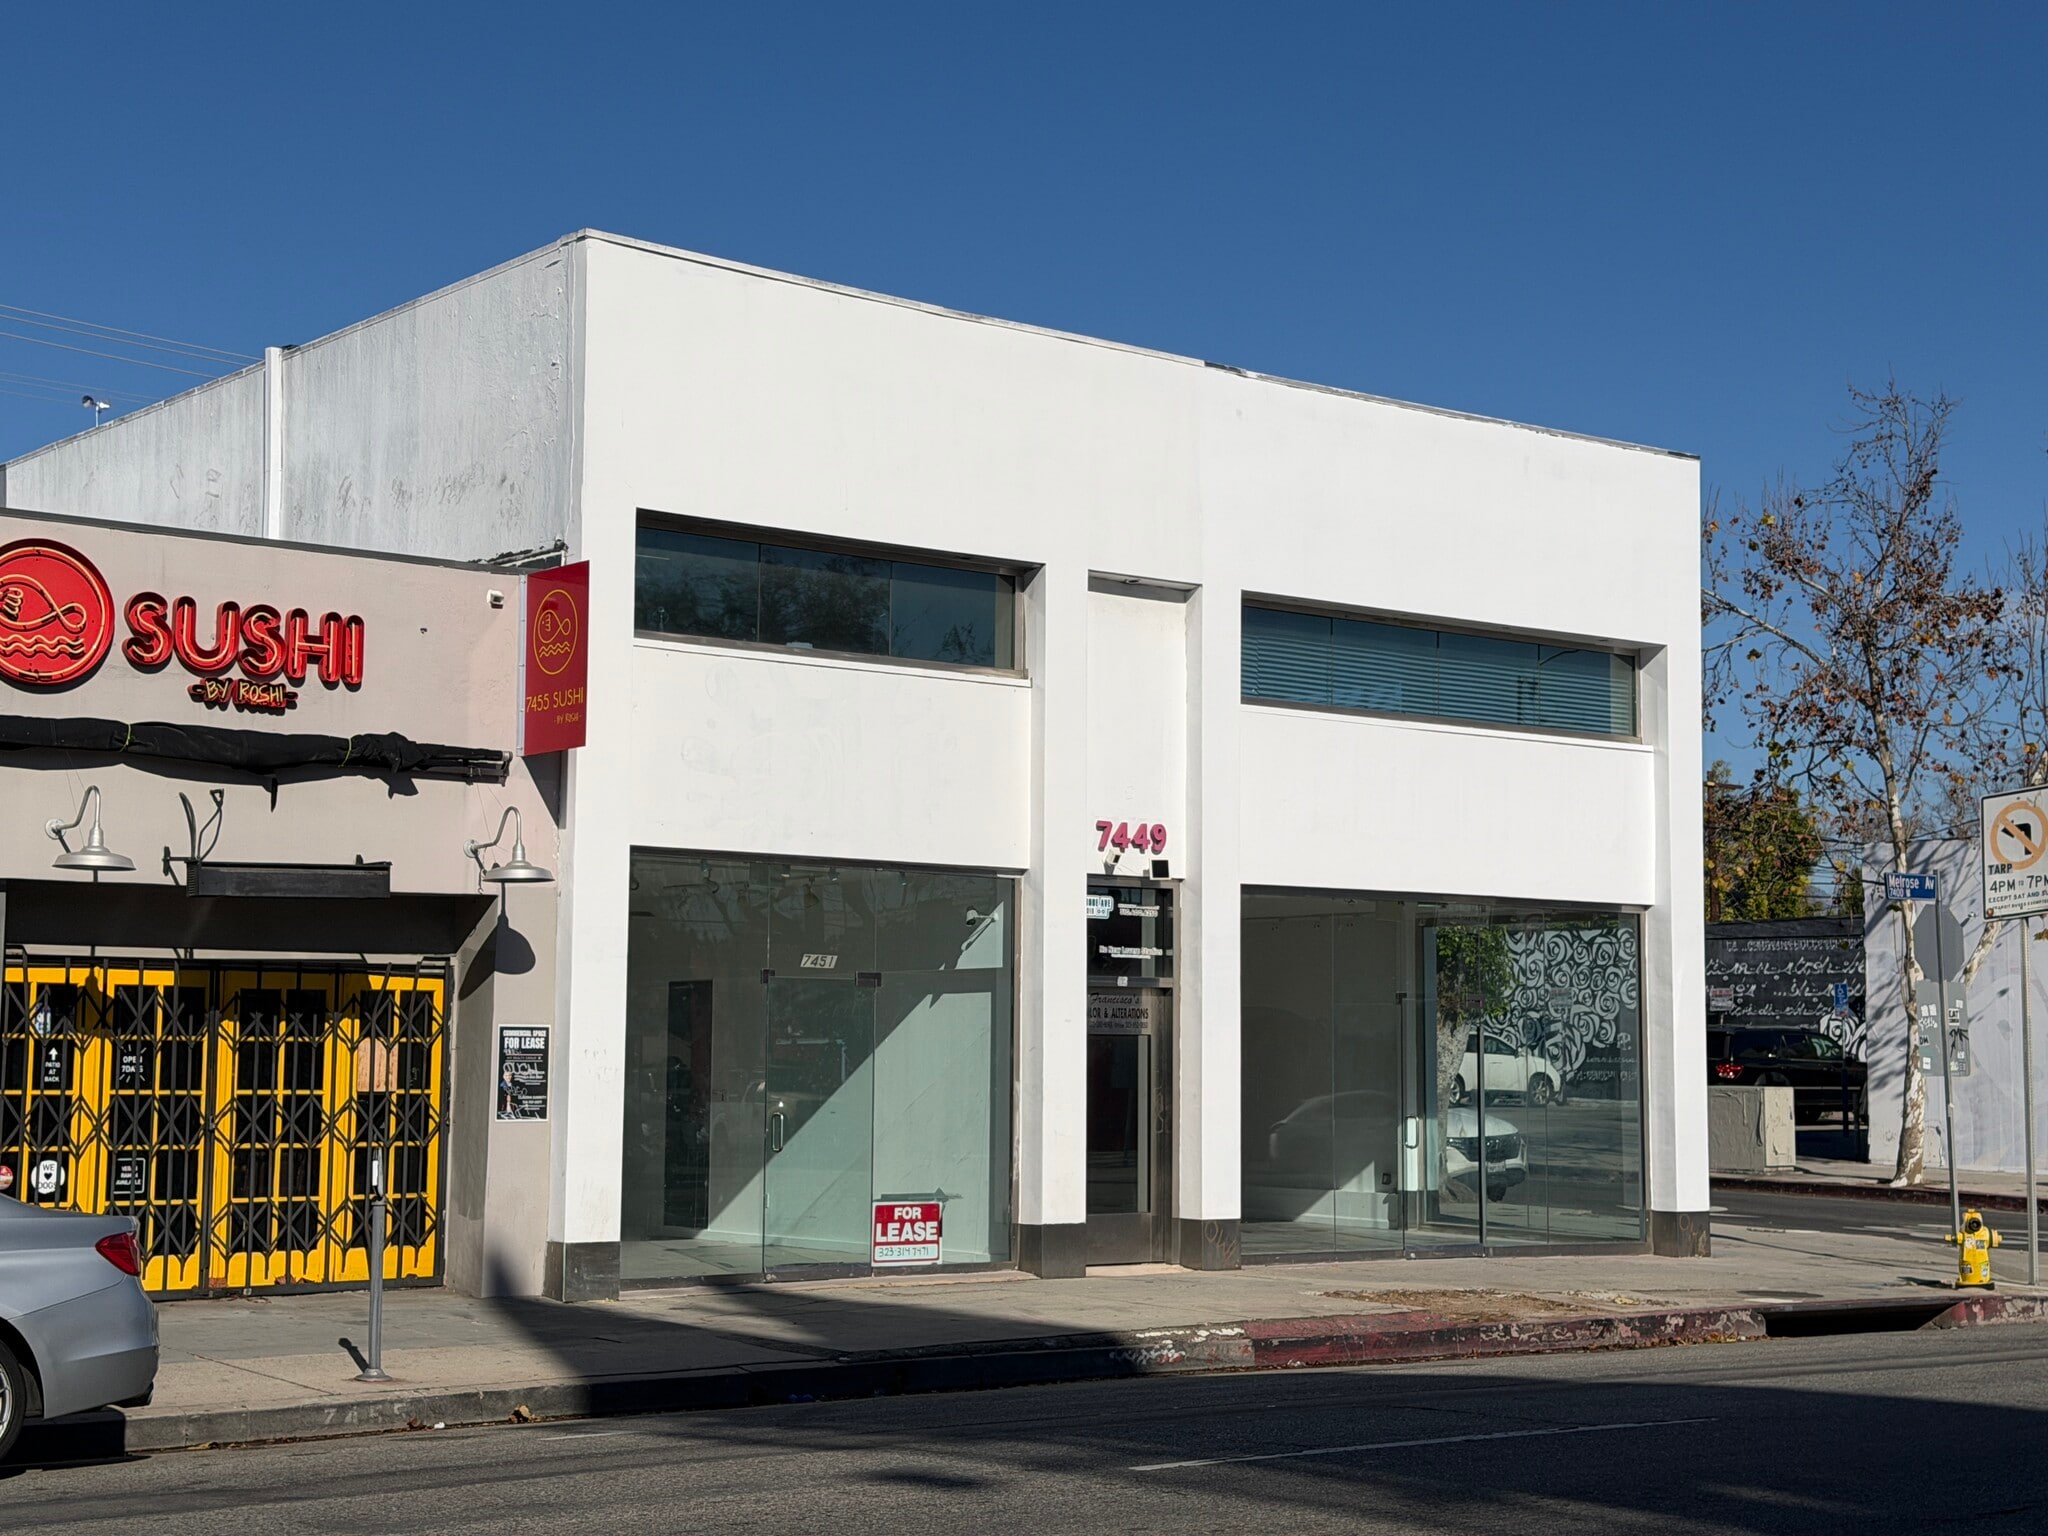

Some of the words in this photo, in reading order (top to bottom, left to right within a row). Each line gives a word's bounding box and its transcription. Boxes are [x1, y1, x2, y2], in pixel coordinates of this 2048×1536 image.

[122, 592, 364, 684] SUSHI
[205, 679, 233, 701] BY
[235, 680, 287, 706] ROSHI
[526, 693, 550, 712] 7455
[553, 686, 584, 708] SUSHI
[1095, 820, 1167, 855] 7449
[1987, 863, 2013, 875] TARP
[1888, 874, 1920, 889] Melrose
[1925, 876, 1935, 890] Av
[1989, 879, 2016, 893] 4PM
[1988, 895, 2012, 904] EXCEPT
[802, 955, 834, 967] 7451
[1112, 1008, 1149, 1019] ALTERATIONS
[504, 1037, 520, 1049] FOR
[521, 1037, 545, 1049] LEASE
[121, 1065, 144, 1073] 7DAS
[42, 1164, 55, 1172] WE
[894, 1206, 922, 1220] FOR
[876, 1221, 938, 1242] LEASE
